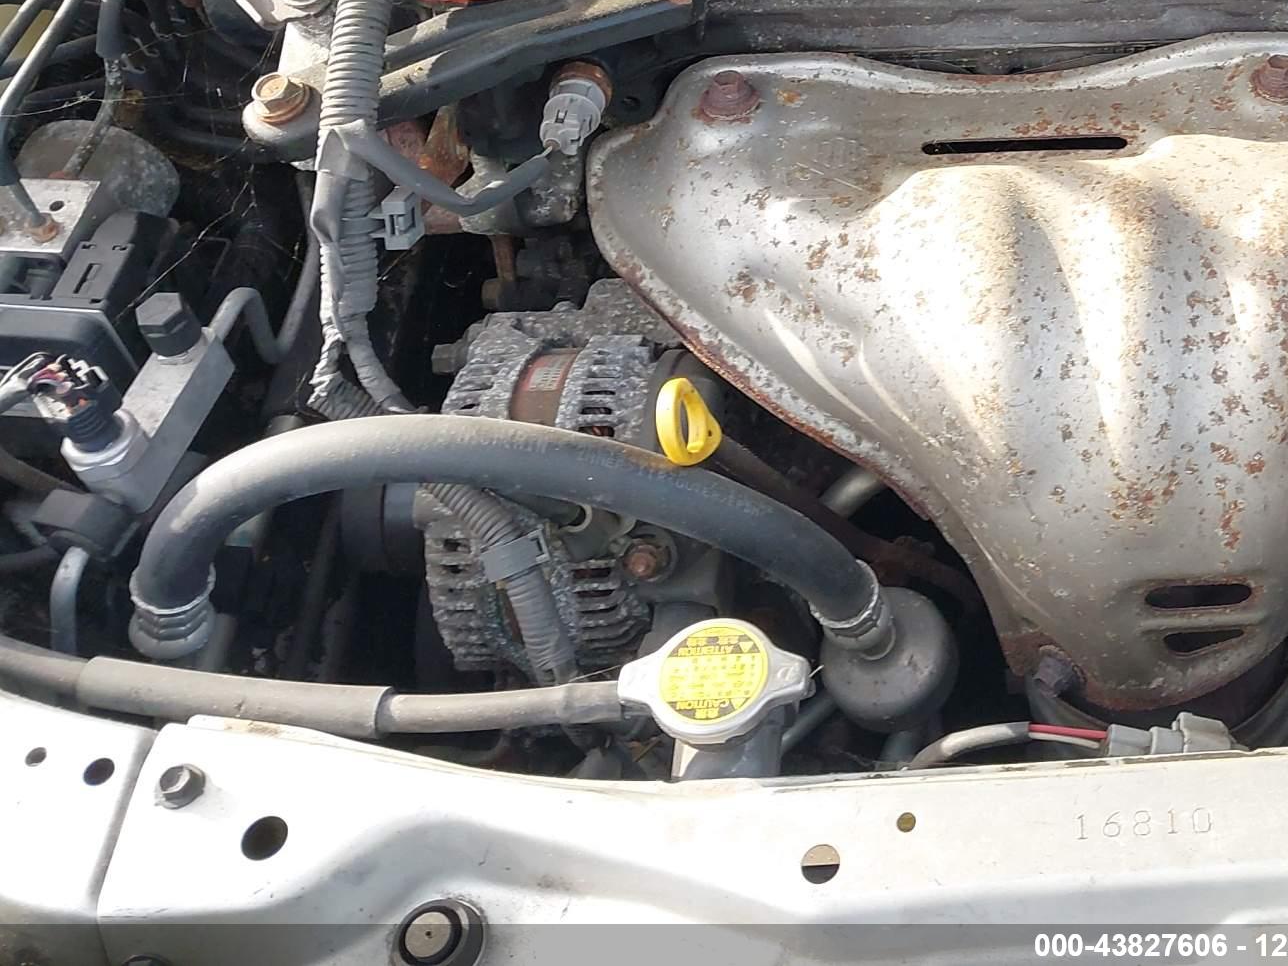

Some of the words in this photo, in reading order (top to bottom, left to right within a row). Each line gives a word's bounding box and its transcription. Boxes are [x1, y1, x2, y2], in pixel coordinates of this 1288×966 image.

[677, 645, 733, 656] ATTENTION
[676, 699, 729, 710] CAUTION
[1074, 806, 1214, 840] 16810
